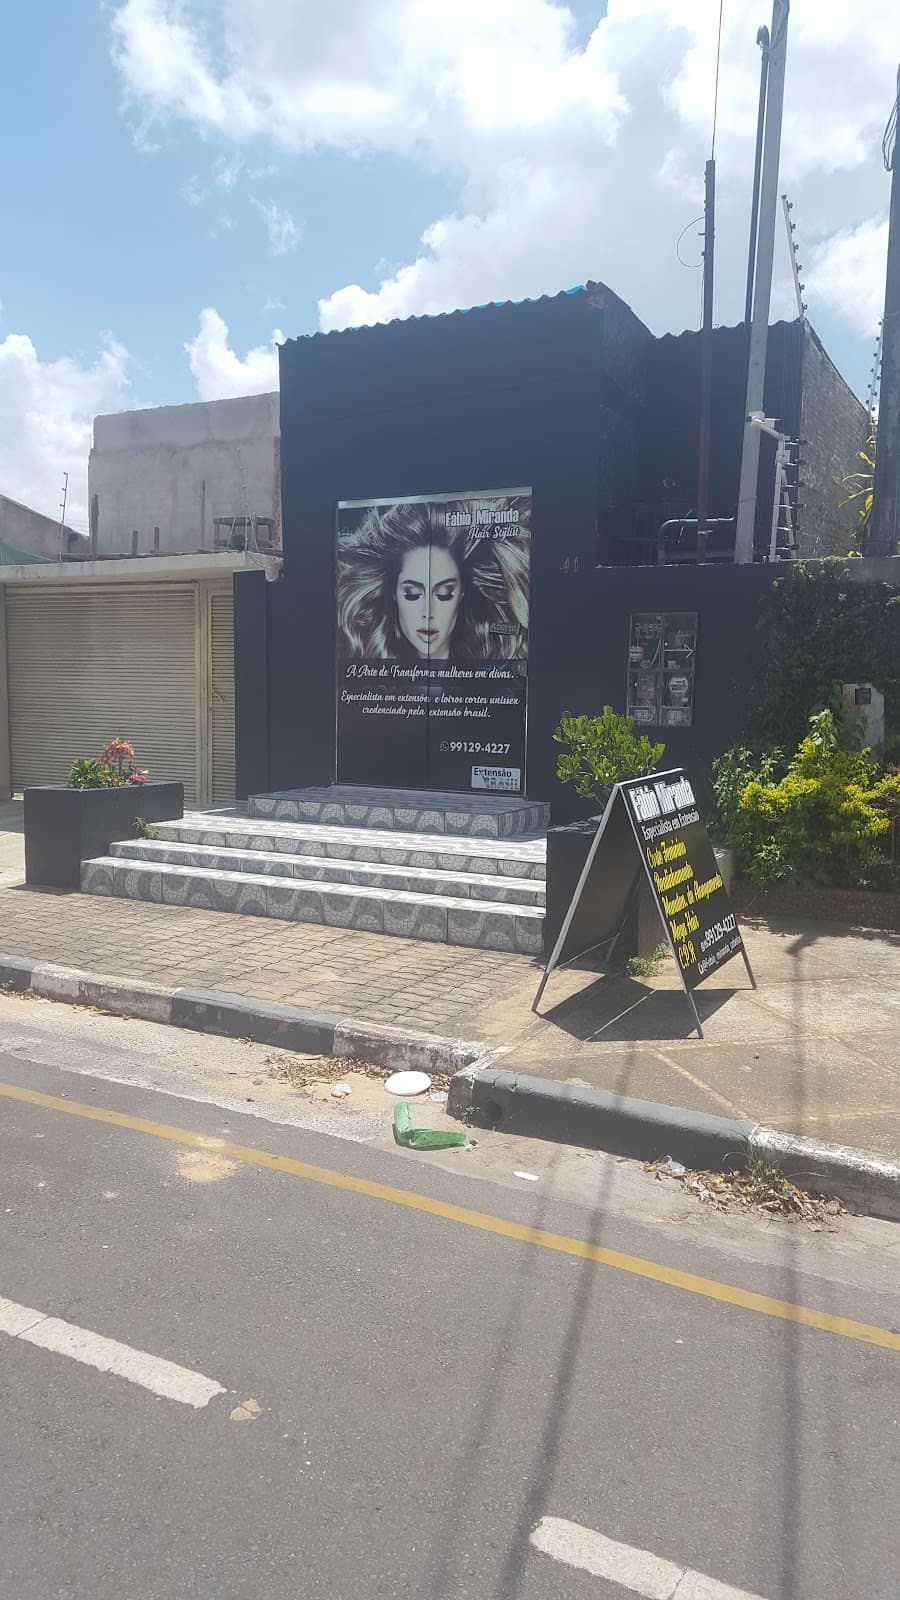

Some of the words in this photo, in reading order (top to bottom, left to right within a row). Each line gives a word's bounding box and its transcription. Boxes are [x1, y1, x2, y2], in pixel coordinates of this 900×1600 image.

[445, 511, 471, 527] Fábio
[476, 508, 519, 525] Miranda
[468, 527, 490, 540] Hair
[346, 664, 357, 678] A
[357, 664, 377, 678] Arte
[378, 664, 388, 677] de
[437, 665, 474, 678] mulheres
[474, 670, 487, 678] em
[488, 665, 514, 679] divas.
[341, 690, 383, 704] Especialista
[440, 692, 463, 704] loiros
[464, 695, 488, 704] cortes
[489, 695, 520, 705] unissex
[362, 703, 406, 715] credenciado
[406, 704, 426, 719] pela
[428, 707, 461, 717] extensão
[463, 705, 491, 718] brasil.
[450, 741, 511, 755] 99129-4227
[628, 785, 661, 822] Fábio
[654, 776, 696, 814] Miranda
[641, 820, 672, 842] Especialista
